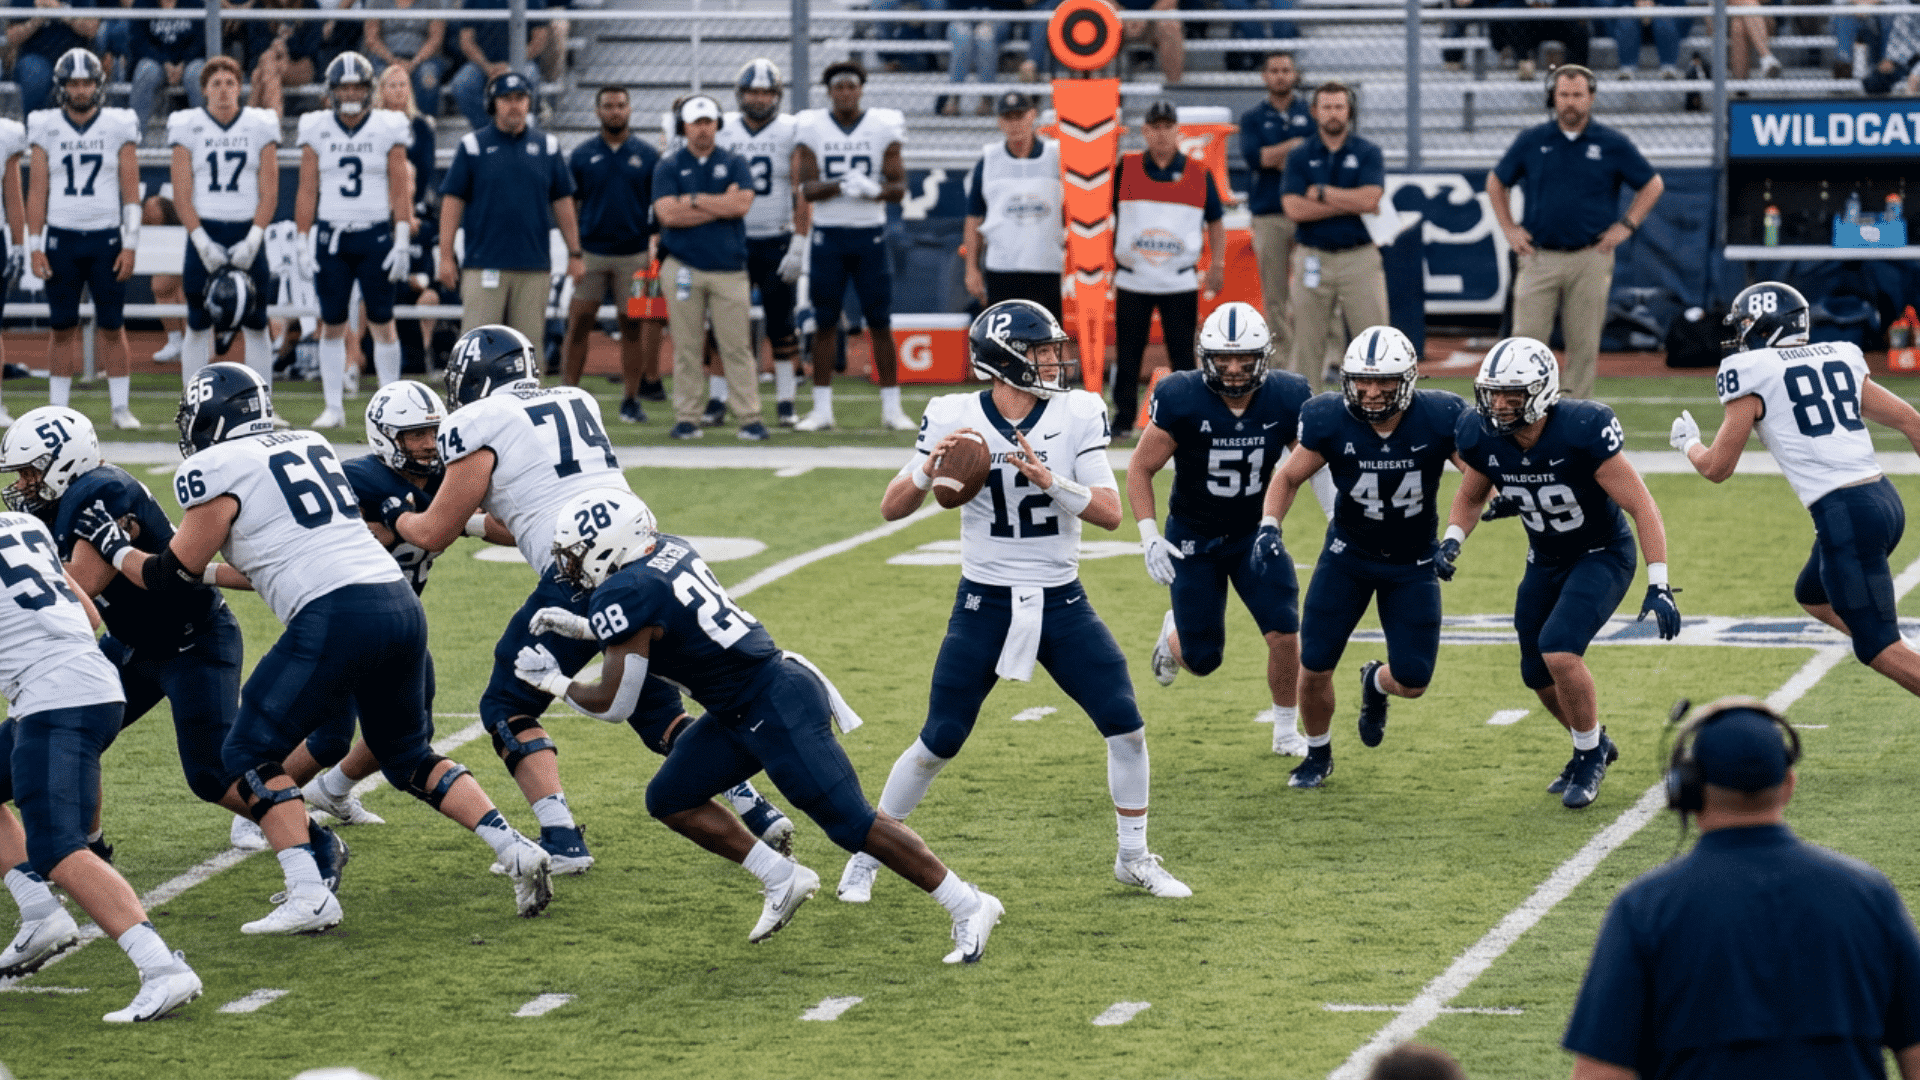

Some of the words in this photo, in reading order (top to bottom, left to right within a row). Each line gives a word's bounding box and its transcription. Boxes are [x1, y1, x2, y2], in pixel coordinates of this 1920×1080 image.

[61, 153, 103, 196] 17
[206, 150, 247, 192] 17
[338, 155, 363, 198] 3
[1748, 291, 1778, 315] 88
[985, 313, 1013, 340] 12
[454, 337, 481, 366] 74
[900, 333, 933, 371] G
[187, 376, 214, 406] 66
[1716, 368, 1740, 397] 88
[1783, 359, 1866, 438] 88
[35, 419, 72, 450] 51
[438, 426, 466, 462] 74
[523, 398, 619, 479] 74
[1601, 416, 1625, 452] 39
[176, 469, 206, 504] 66
[269, 444, 363, 530] 66
[1206, 447, 1265, 498] 51
[984, 467, 1060, 539] 12
[1349, 469, 1424, 521] 44
[1501, 483, 1585, 533] 39
[574, 502, 612, 541] 28
[591, 603, 630, 641] 28
